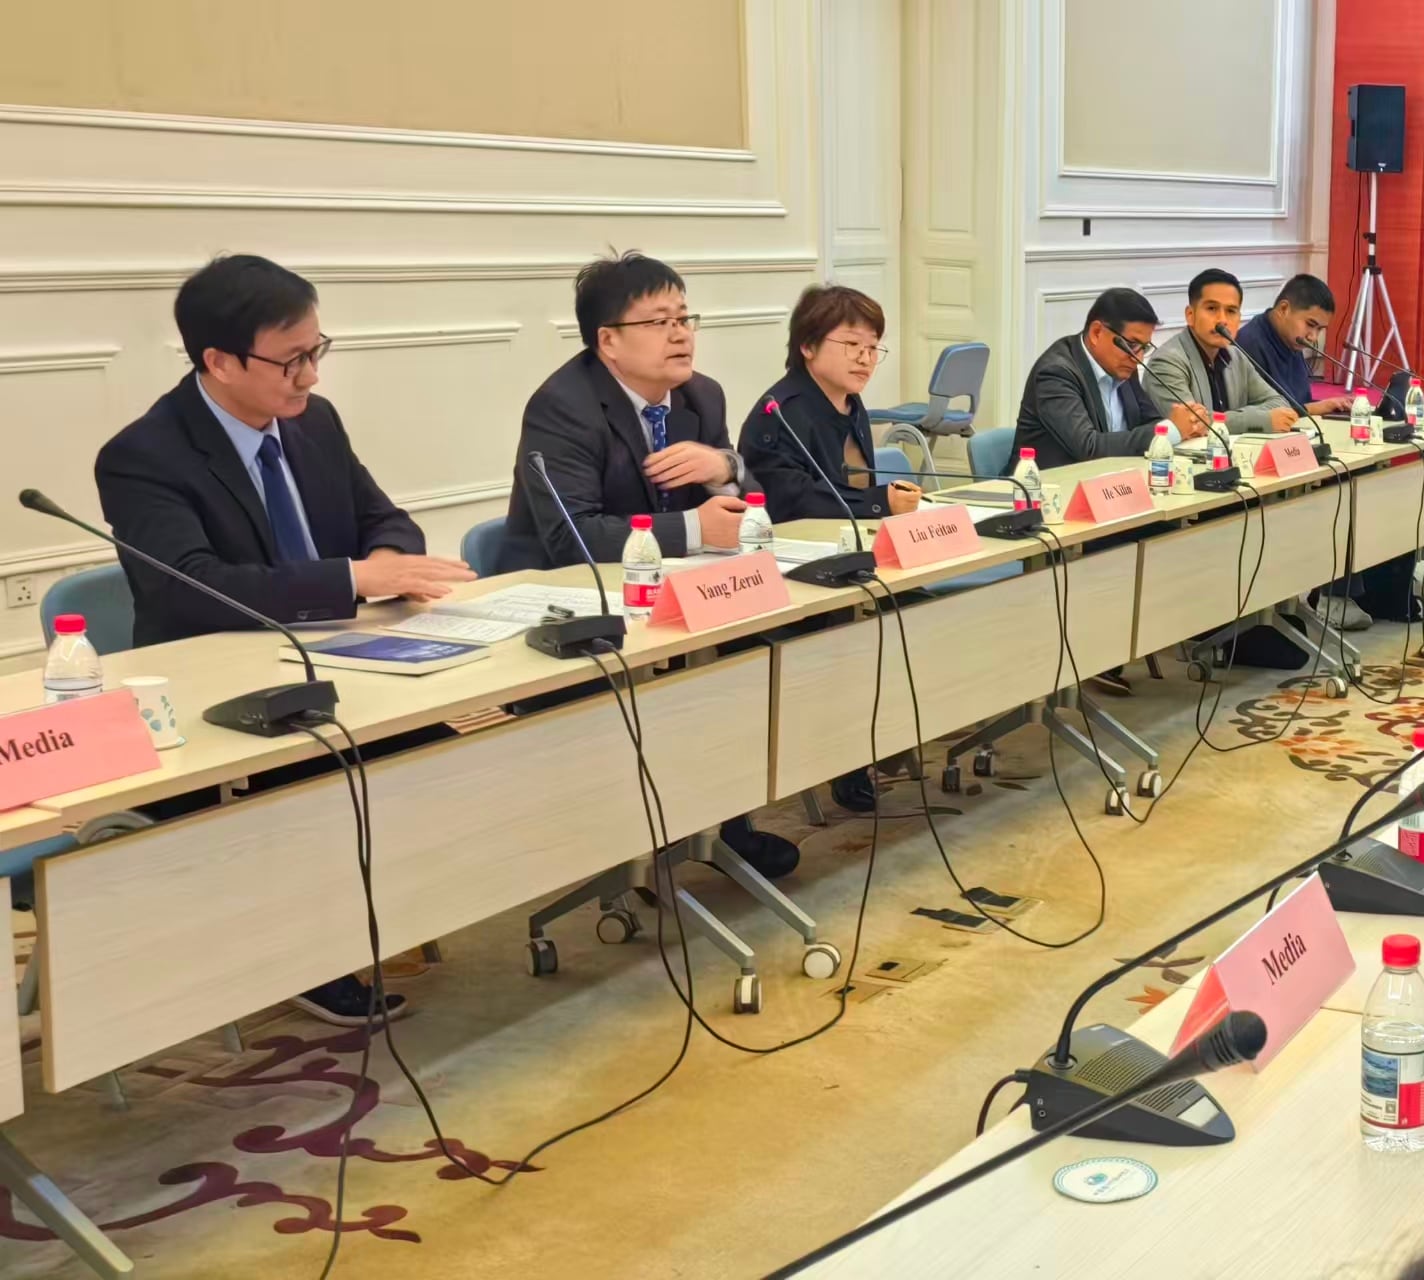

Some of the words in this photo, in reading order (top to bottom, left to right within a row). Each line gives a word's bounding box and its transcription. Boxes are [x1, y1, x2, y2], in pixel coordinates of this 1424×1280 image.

[1113, 482, 1133, 497] Xilin
[908, 528, 928, 543] Liu
[928, 523, 958, 539] Feitao
[696, 582, 732, 601] Yang
[729, 569, 765, 592] Zerui
[0, 729, 75, 766] Media
[1261, 932, 1307, 986] Media
